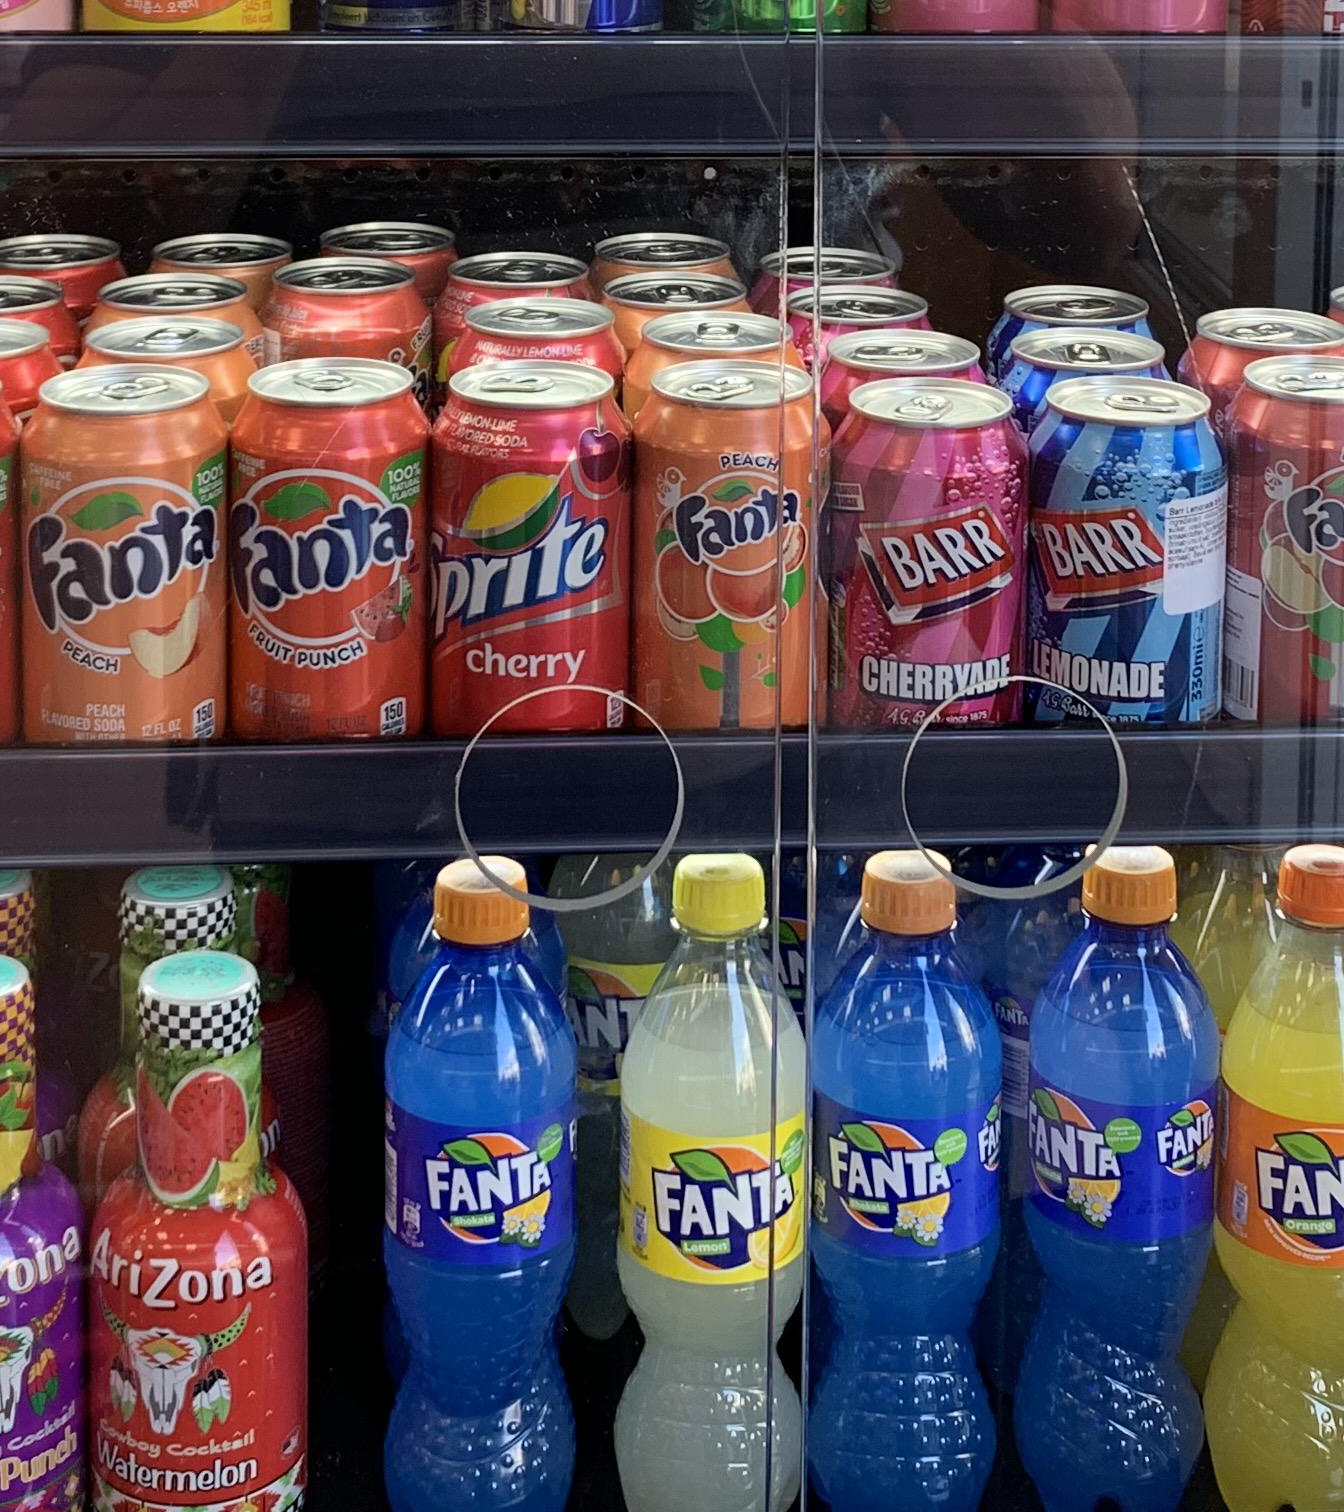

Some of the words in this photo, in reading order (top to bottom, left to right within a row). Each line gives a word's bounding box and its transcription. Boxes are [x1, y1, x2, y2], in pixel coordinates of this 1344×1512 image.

[387, 462, 423, 489] 100%
[675, 486, 799, 564] Fanta
[1044, 516, 1164, 583] BARR
[28, 501, 218, 636] Fanta
[432, 490, 608, 638] prite
[886, 514, 1008, 594] BARR
[61, 637, 122, 676] PEACH
[248, 622, 294, 665] FRUIT
[295, 638, 367, 670] PUNCH
[465, 641, 586, 684] cherry
[1032, 637, 1166, 700] LEMONADE
[861, 652, 1013, 702] CHERRYADE
[85, 703, 126, 718] PEACH
[94, 716, 126, 733] SODA
[193, 702, 214, 723] 150
[381, 701, 404, 721] 150
[1028, 1106, 1121, 1178] FANTA
[1157, 1108, 1214, 1158] FANTA
[425, 1157, 552, 1213] FANTA
[830, 1135, 952, 1200] FANTA
[653, 1168, 795, 1236] FANTA
[1284, 1219, 1336, 1234] Orange
[88, 1226, 274, 1309] AriZona
[682, 1240, 728, 1255] Lemon
[0, 1431, 79, 1494] Punch
[96, 1434, 258, 1494] Watermelon
[166, 1430, 256, 1458] Cocktail
